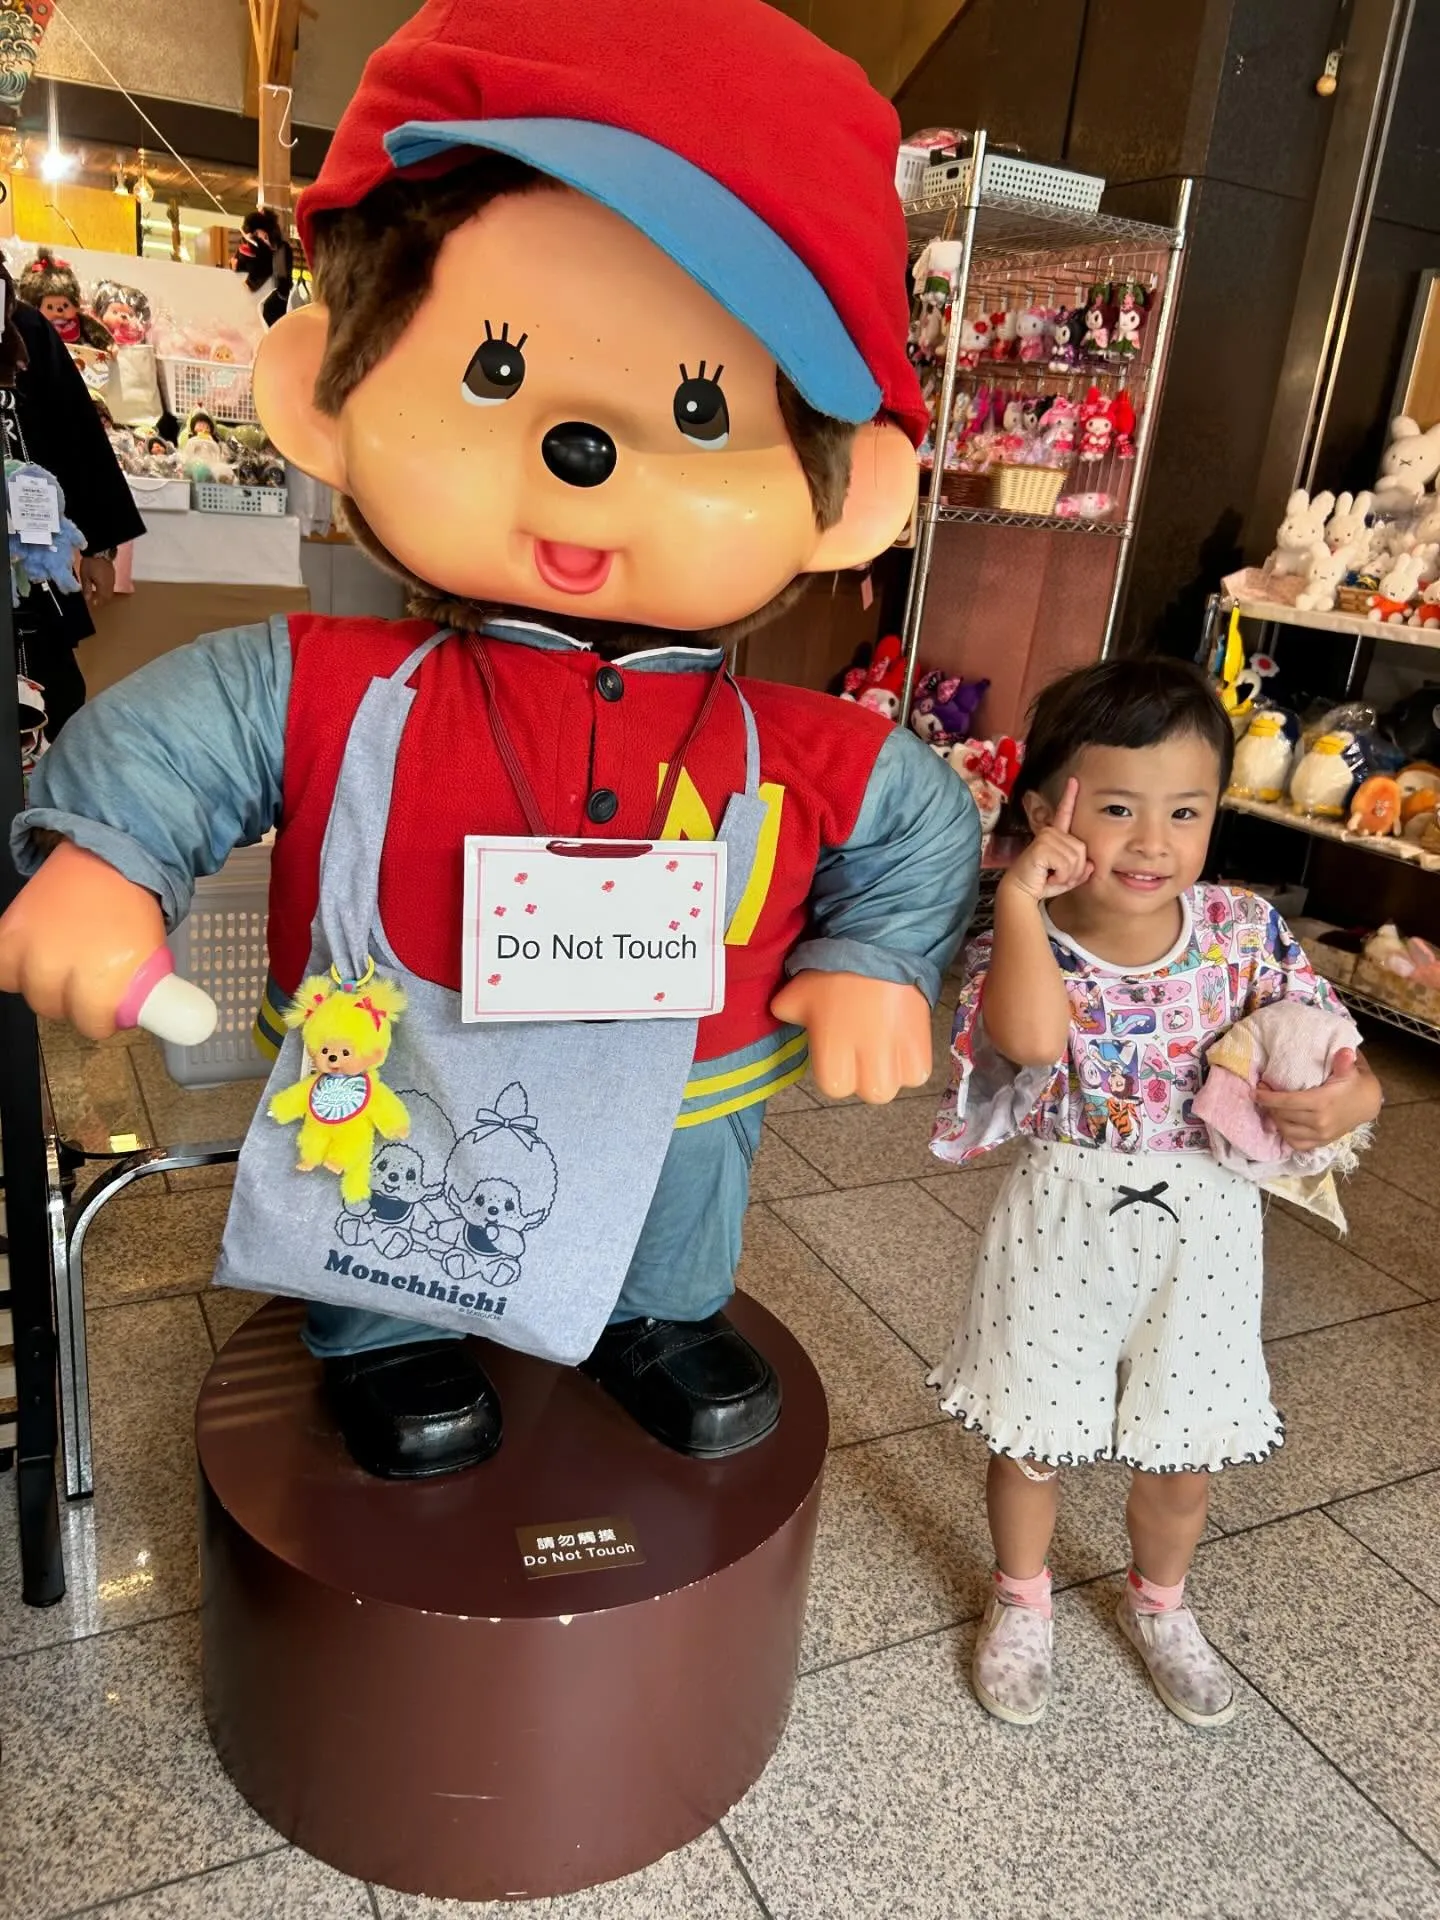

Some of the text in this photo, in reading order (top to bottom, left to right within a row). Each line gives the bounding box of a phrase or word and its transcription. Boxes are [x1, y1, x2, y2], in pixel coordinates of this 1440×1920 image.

[497, 933, 698, 960] Do Not Touch
[324, 1249, 508, 1316] Monchhichi
[536, 1528, 617, 1550] 請勿觸摸
[524, 1542, 636, 1567] Do Not Touch
